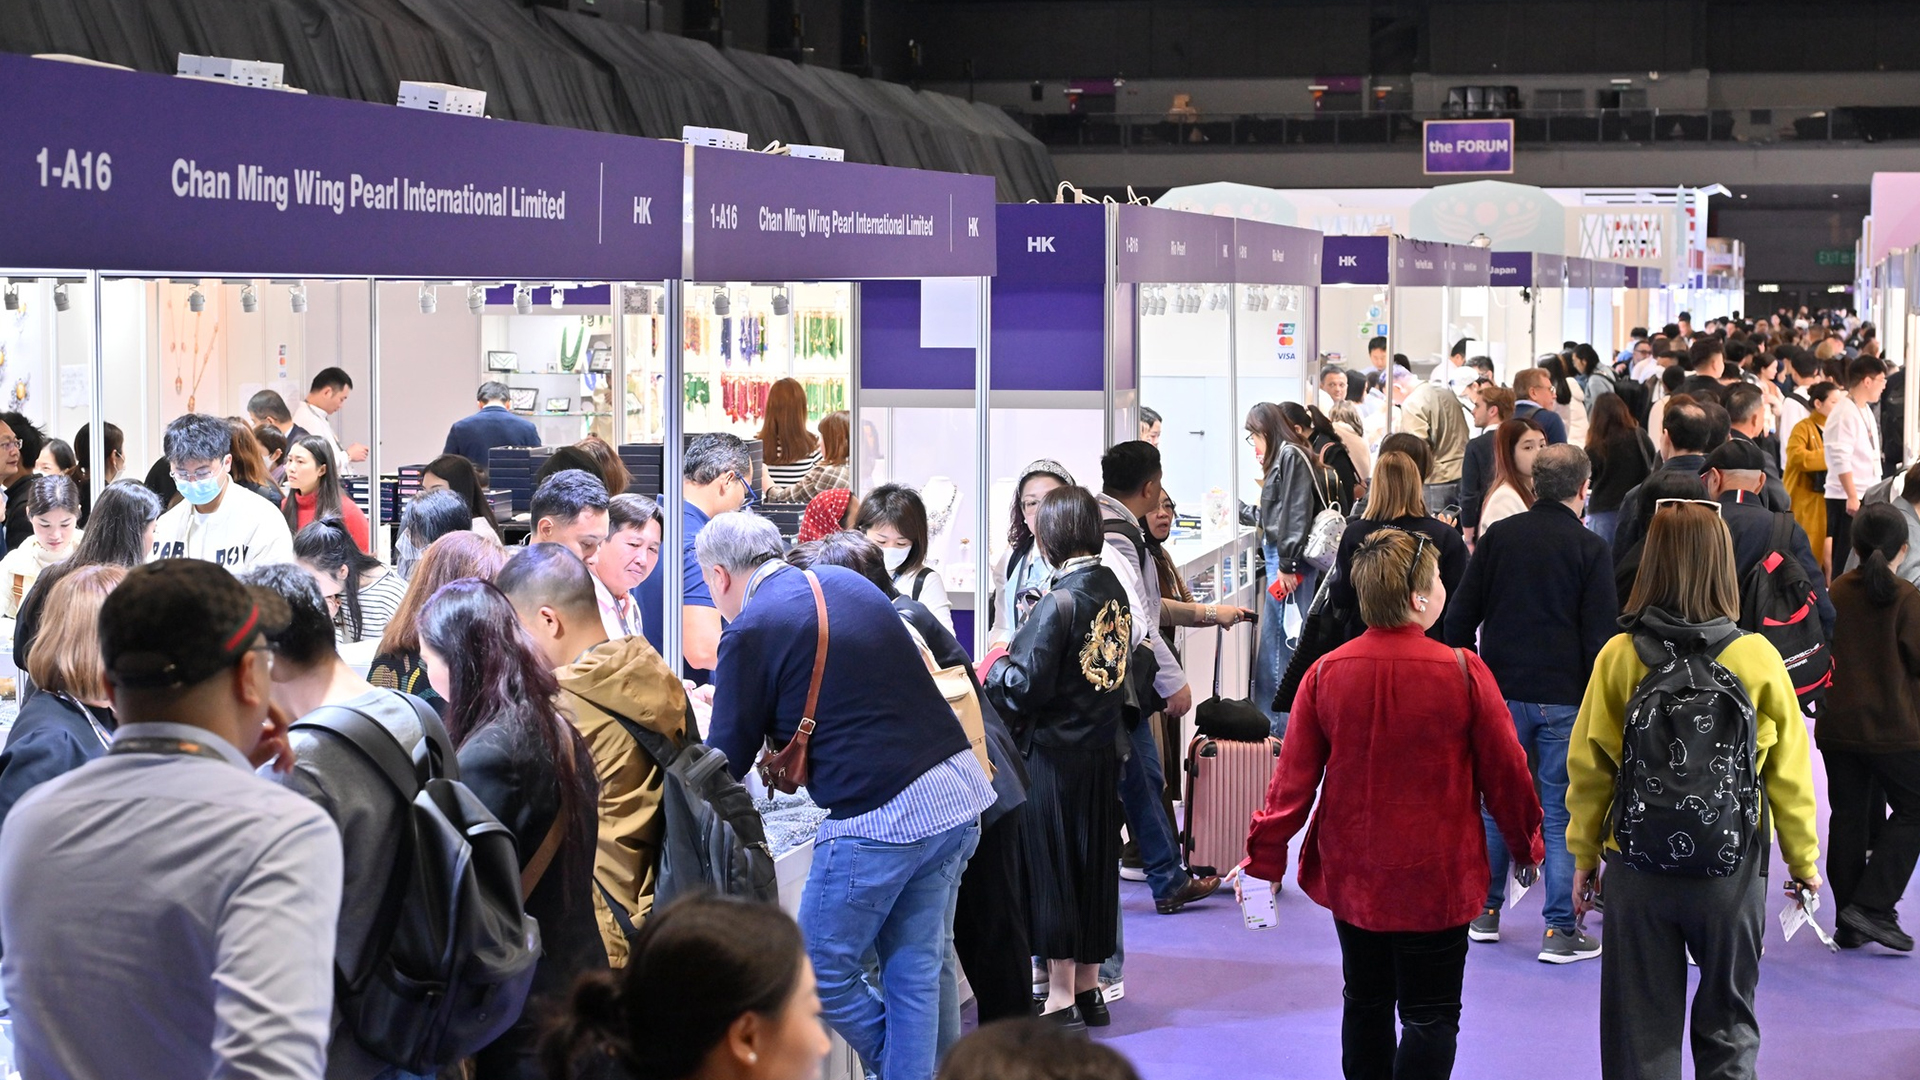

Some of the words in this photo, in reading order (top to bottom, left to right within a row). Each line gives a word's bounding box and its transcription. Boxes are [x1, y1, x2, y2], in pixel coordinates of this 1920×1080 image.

[1428, 140, 1454, 154] the
[1457, 140, 1509, 154] FORUM
[37, 147, 112, 192] 1-A16
[171, 158, 231, 200] Chan
[237, 164, 289, 212] Ming
[293, 168, 345, 215] Wing
[350, 173, 399, 210] Pearl
[403, 177, 508, 217] International
[511, 186, 566, 221] Limited
[633, 196, 652, 225] HK
[710, 203, 738, 230] 1-A16
[759, 205, 783, 232] Chan
[784, 207, 807, 238] Ming
[808, 208, 831, 239] Wing
[832, 209, 855, 234] Pearl
[856, 211, 905, 236] International
[906, 213, 934, 237] Limited
[968, 216, 980, 237] HK
[1027, 236, 1056, 253] HK
[1338, 255, 1357, 267] HK
[1489, 265, 1517, 276] Japan
[1277, 352, 1296, 360] VISA
